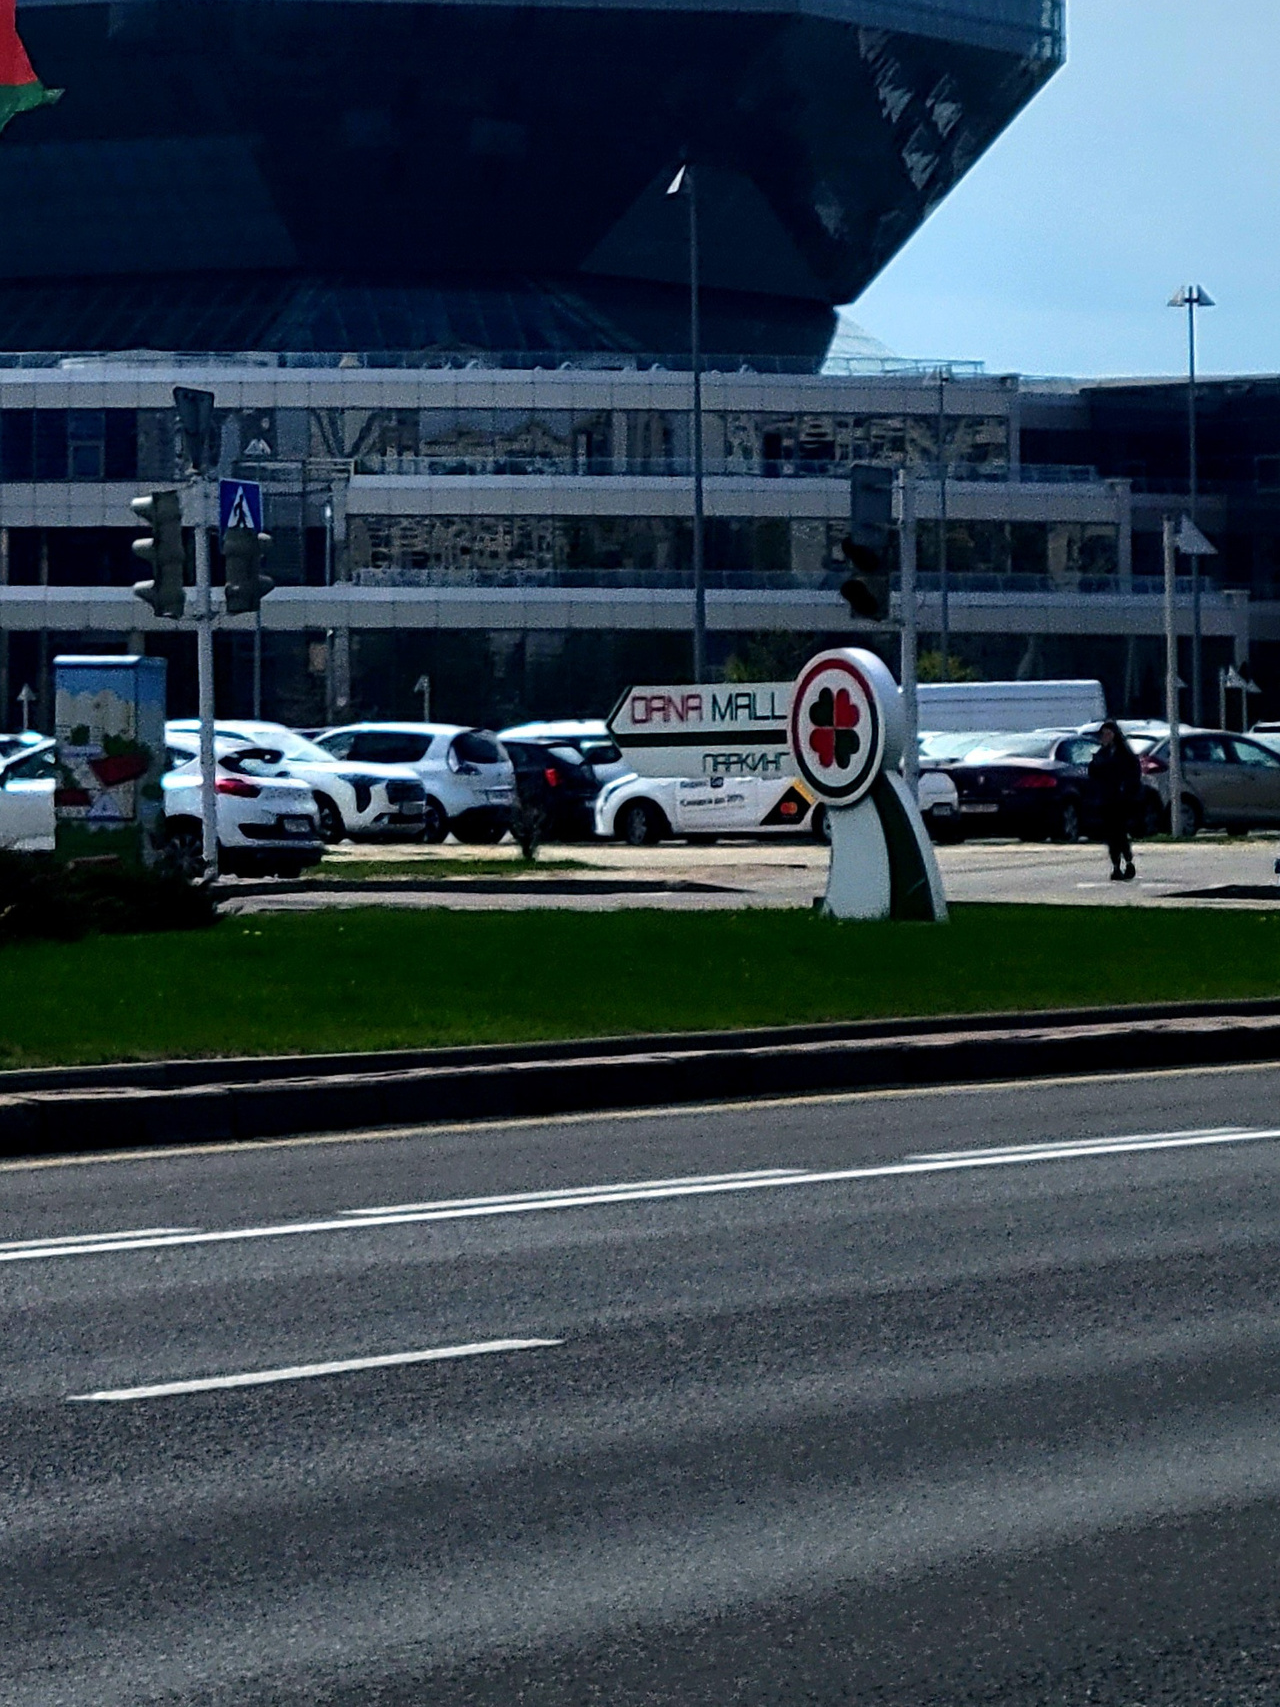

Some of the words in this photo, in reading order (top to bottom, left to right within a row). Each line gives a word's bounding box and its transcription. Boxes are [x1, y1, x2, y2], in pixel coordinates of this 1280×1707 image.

[631, 693, 703, 725] DANA
[711, 691, 788, 723] MALL
[702, 751, 791, 773] ПАРКИНГ
